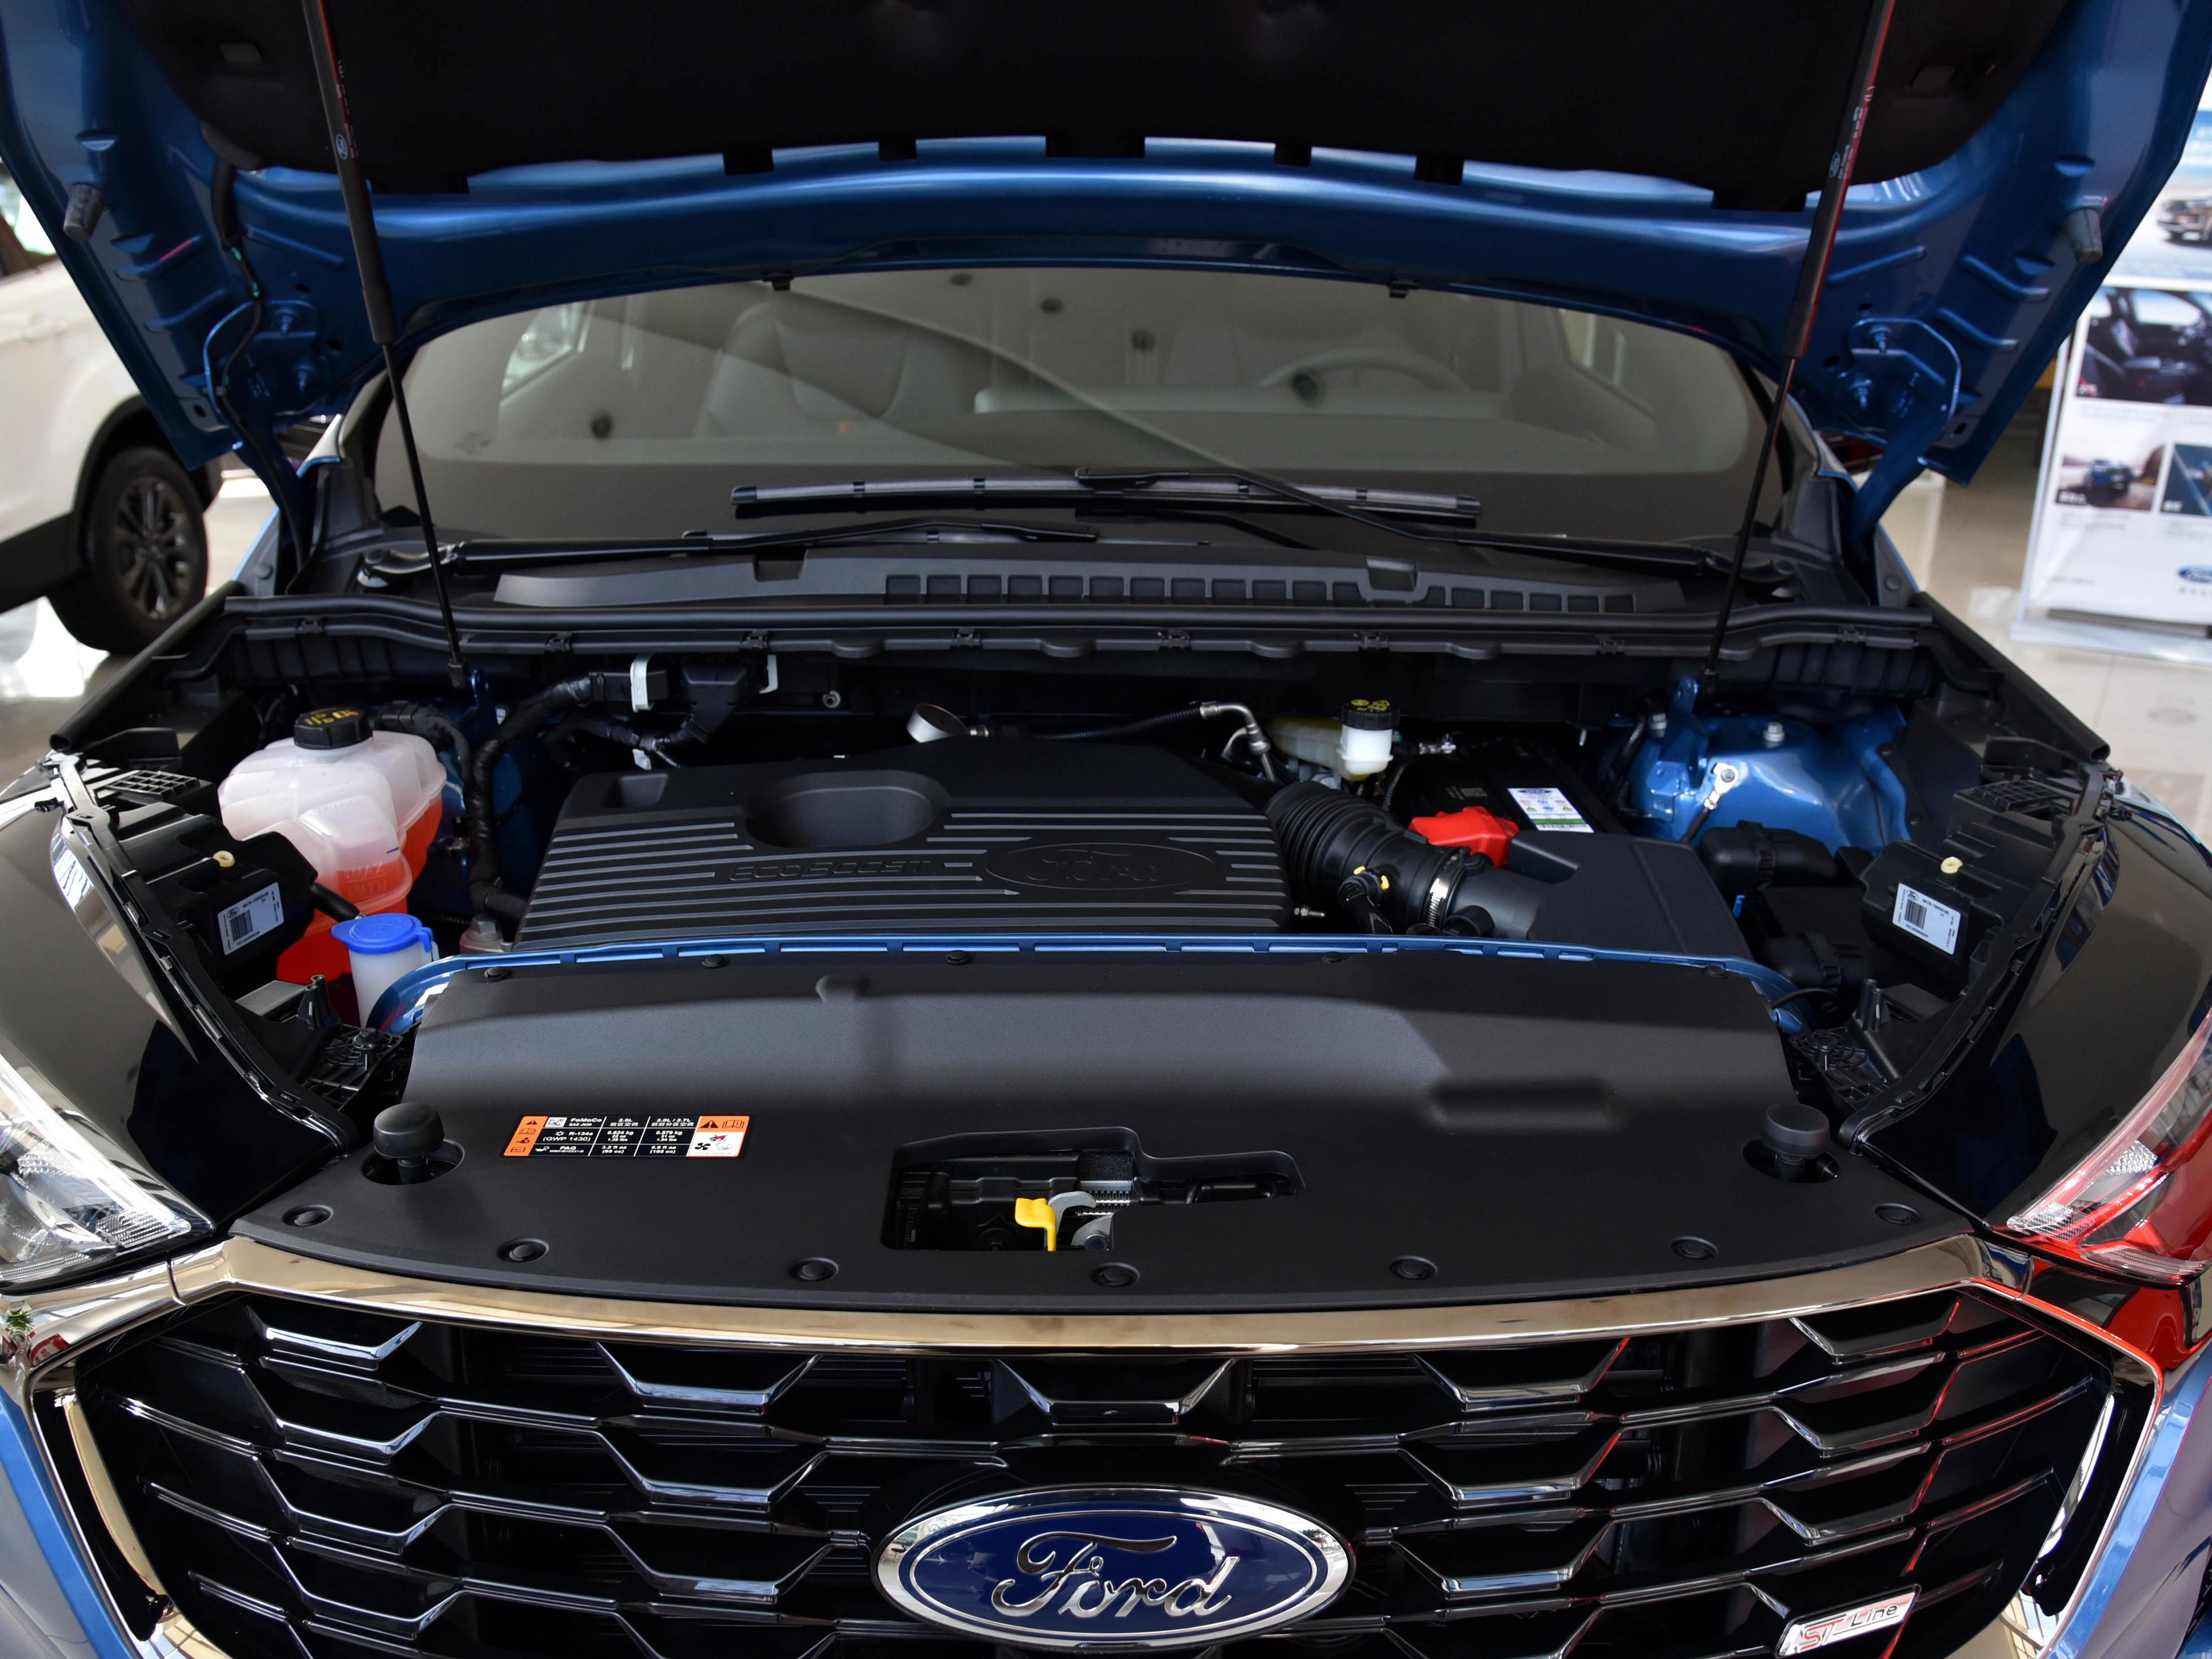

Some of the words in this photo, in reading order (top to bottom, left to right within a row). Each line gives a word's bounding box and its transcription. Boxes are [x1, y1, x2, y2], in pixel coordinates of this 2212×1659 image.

[990, 1530, 1241, 1619] Ford
[1797, 1616, 1846, 1652] ST
[1850, 1604, 1898, 1627] Line
